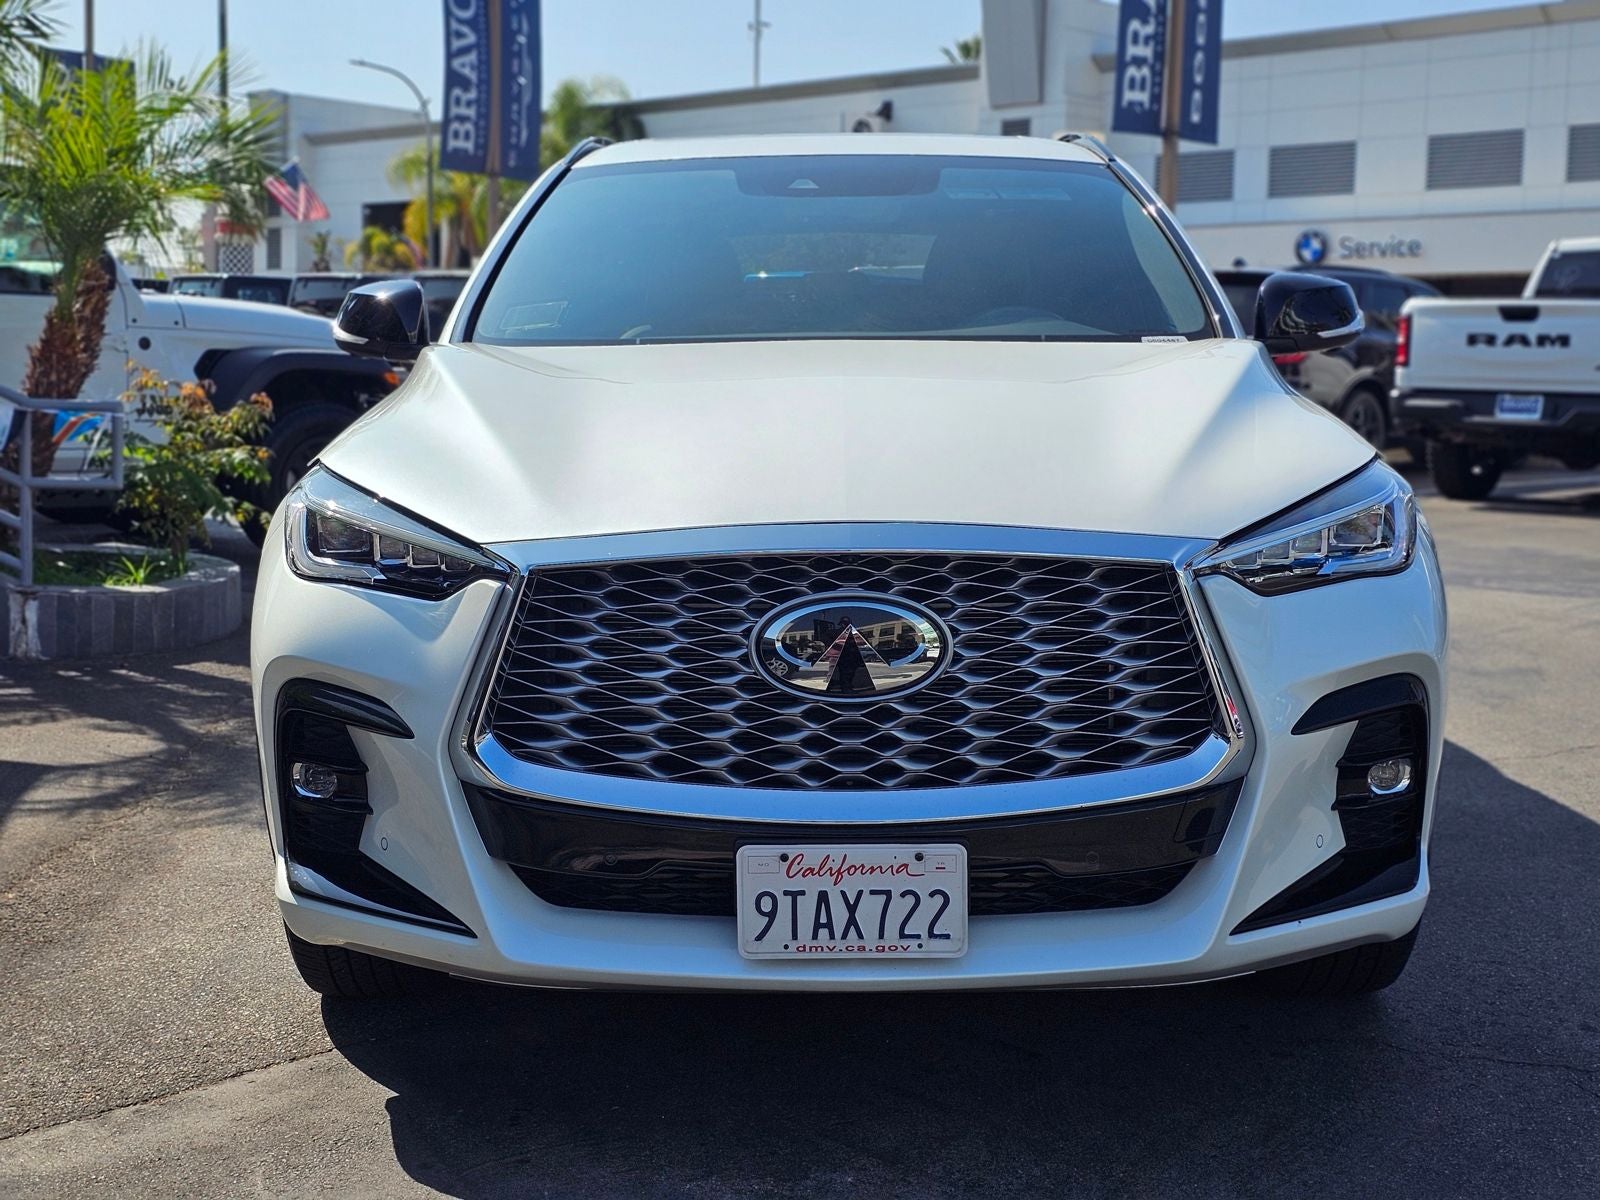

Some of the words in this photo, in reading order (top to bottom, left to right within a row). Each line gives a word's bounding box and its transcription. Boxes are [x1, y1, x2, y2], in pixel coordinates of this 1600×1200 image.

[1339, 234, 1423, 259] Service
[1466, 332, 1571, 348] RAM
[785, 853, 925, 887] California
[754, 889, 951, 942] 9TAX722
[795, 943, 912, 953] dmv.ca.gov
